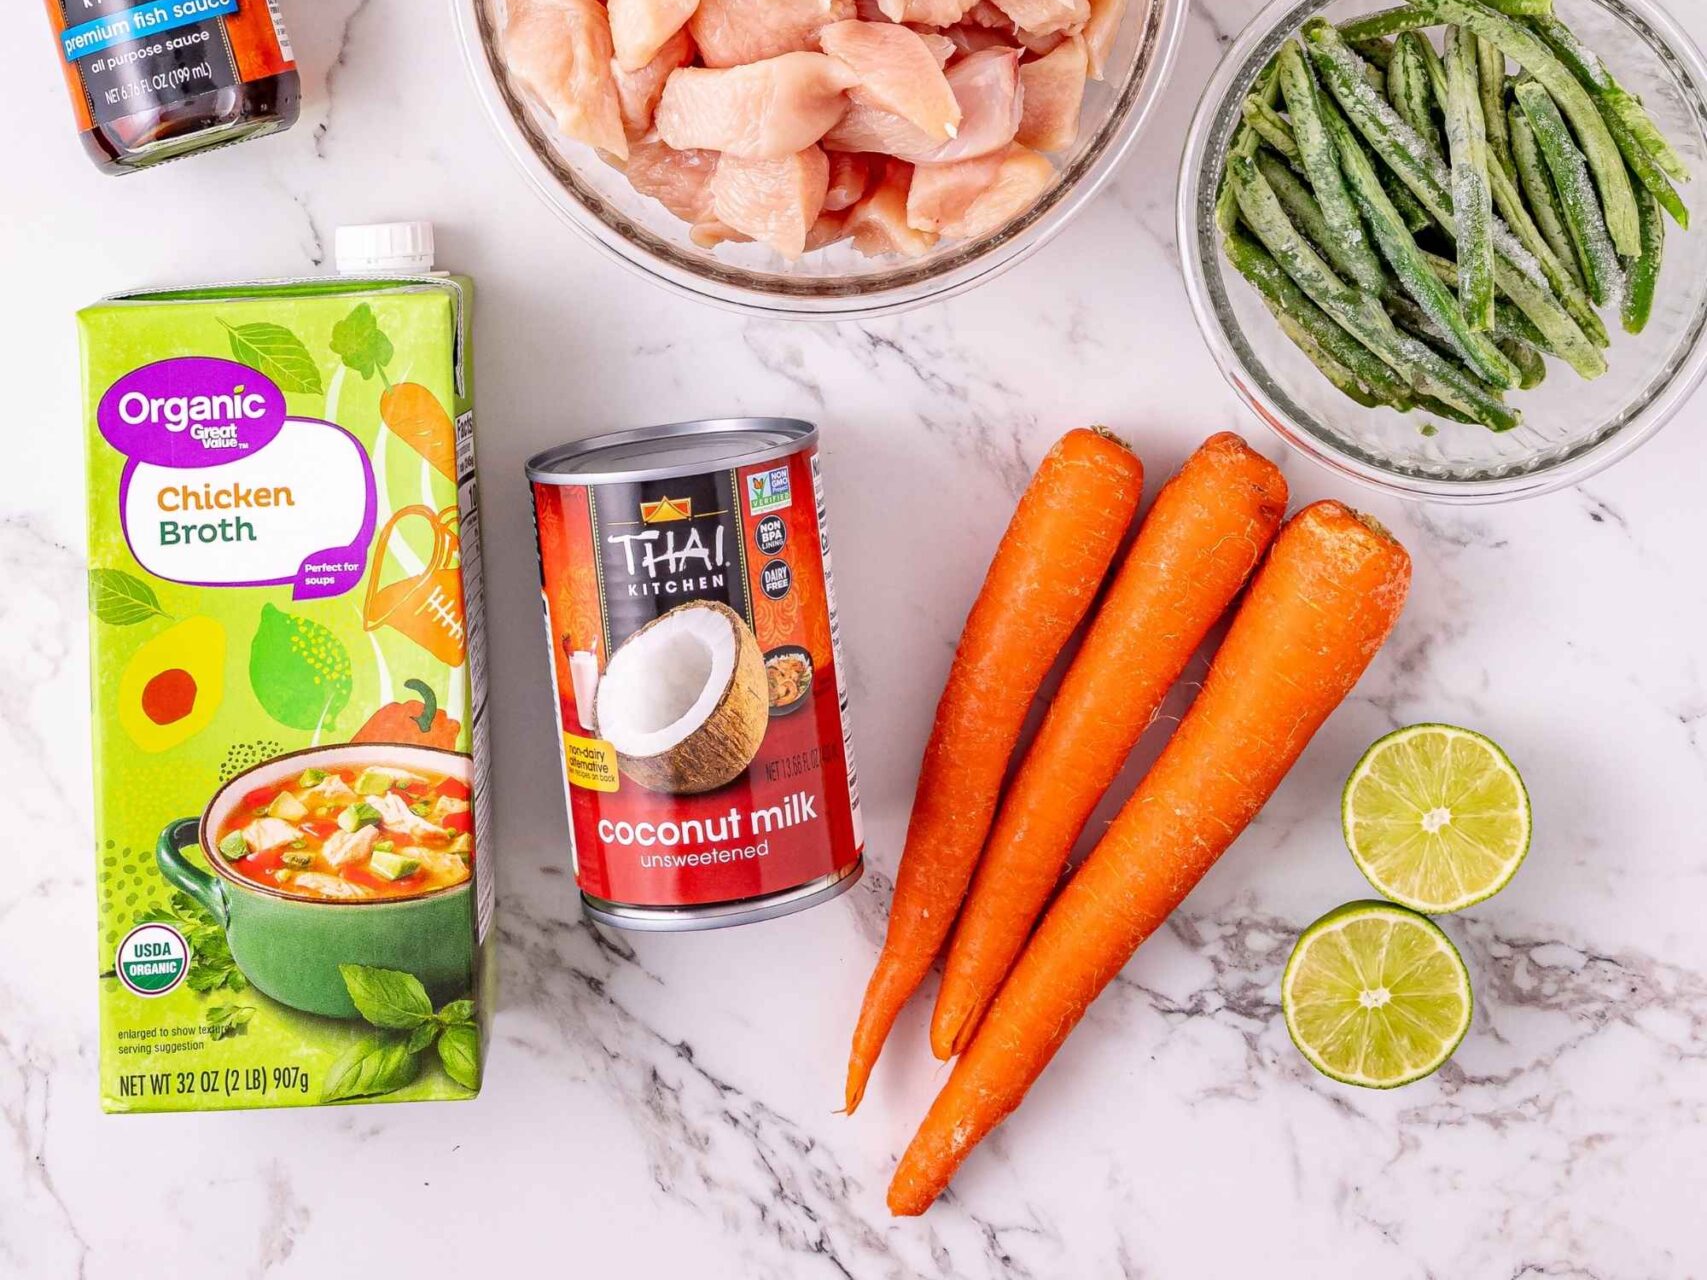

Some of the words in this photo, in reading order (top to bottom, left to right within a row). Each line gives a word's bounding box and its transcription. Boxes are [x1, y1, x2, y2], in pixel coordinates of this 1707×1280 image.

[64, 19, 130, 56] premium
[133, 7, 168, 30] fish
[91, 59, 105, 74] all
[108, 43, 163, 71] purpose
[165, 30, 210, 51] sauce
[104, 88, 121, 105] NET
[121, 83, 141, 100] 6.76
[140, 79, 153, 95] FL
[153, 74, 169, 90] OZ
[168, 68, 190, 89] (199
[192, 61, 213, 80] mL)
[118, 384, 267, 433] Organic
[190, 422, 238, 440] Great
[202, 437, 238, 449] Value
[770, 468, 788, 480] NON
[771, 477, 789, 488] GMO
[157, 482, 295, 512] Chicken
[751, 492, 790, 507] VERIFIED
[159, 516, 257, 546] Broth
[760, 520, 781, 533] NON
[761, 530, 783, 543] BPA
[607, 525, 724, 579] THAI
[305, 563, 343, 573] Perfect
[343, 562, 360, 572] for
[764, 565, 787, 584] DAIRY
[305, 577, 336, 586] soups
[628, 574, 724, 597] KITCHEN
[765, 578, 789, 593] FREE
[598, 807, 742, 847] coconut
[751, 790, 818, 836] milk
[640, 839, 769, 868] unsweetened
[134, 941, 172, 958] USDA
[129, 961, 177, 977] ORGANIC
[118, 1028, 157, 1040] enlarged
[160, 1027, 169, 1037] to
[171, 1026, 196, 1037] show
[118, 1043, 152, 1055] serving
[154, 1041, 205, 1054] suggestion
[119, 1074, 146, 1097] NET
[150, 1073, 172, 1095] WT
[176, 1071, 195, 1094] 32
[200, 1070, 220, 1092] OZ
[224, 1068, 240, 1097] (2
[245, 1066, 267, 1095] LB)
[273, 1066, 309, 1094] 907g
